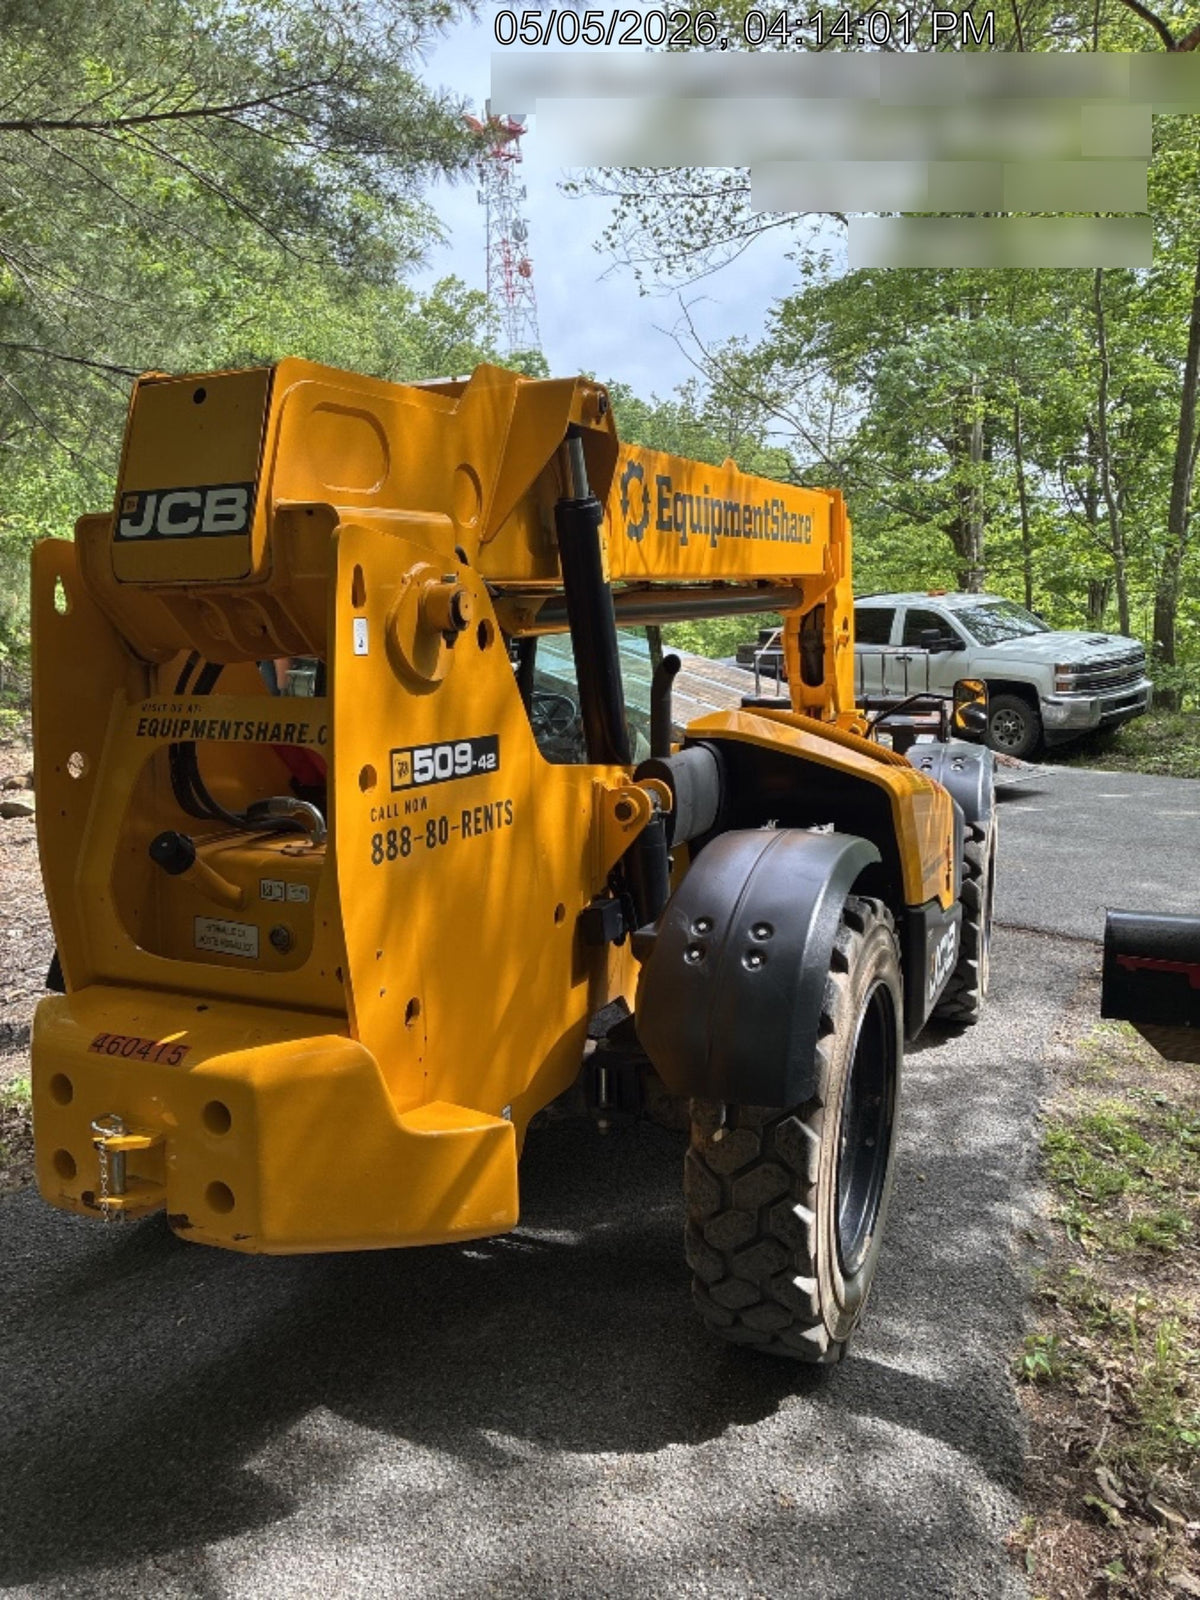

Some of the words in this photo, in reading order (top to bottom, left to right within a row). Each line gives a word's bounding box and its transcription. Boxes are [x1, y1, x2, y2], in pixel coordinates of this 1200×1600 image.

[120, 488, 249, 537] JCB
[655, 474, 812, 548] EquipmentShare
[136, 717, 327, 743] EQUIPMENTSHARE.C
[371, 804, 399, 822] CALL
[405, 796, 427, 814] NOW
[371, 799, 513, 865] 888-80-RENTS
[91, 1033, 187, 1066] 460415
